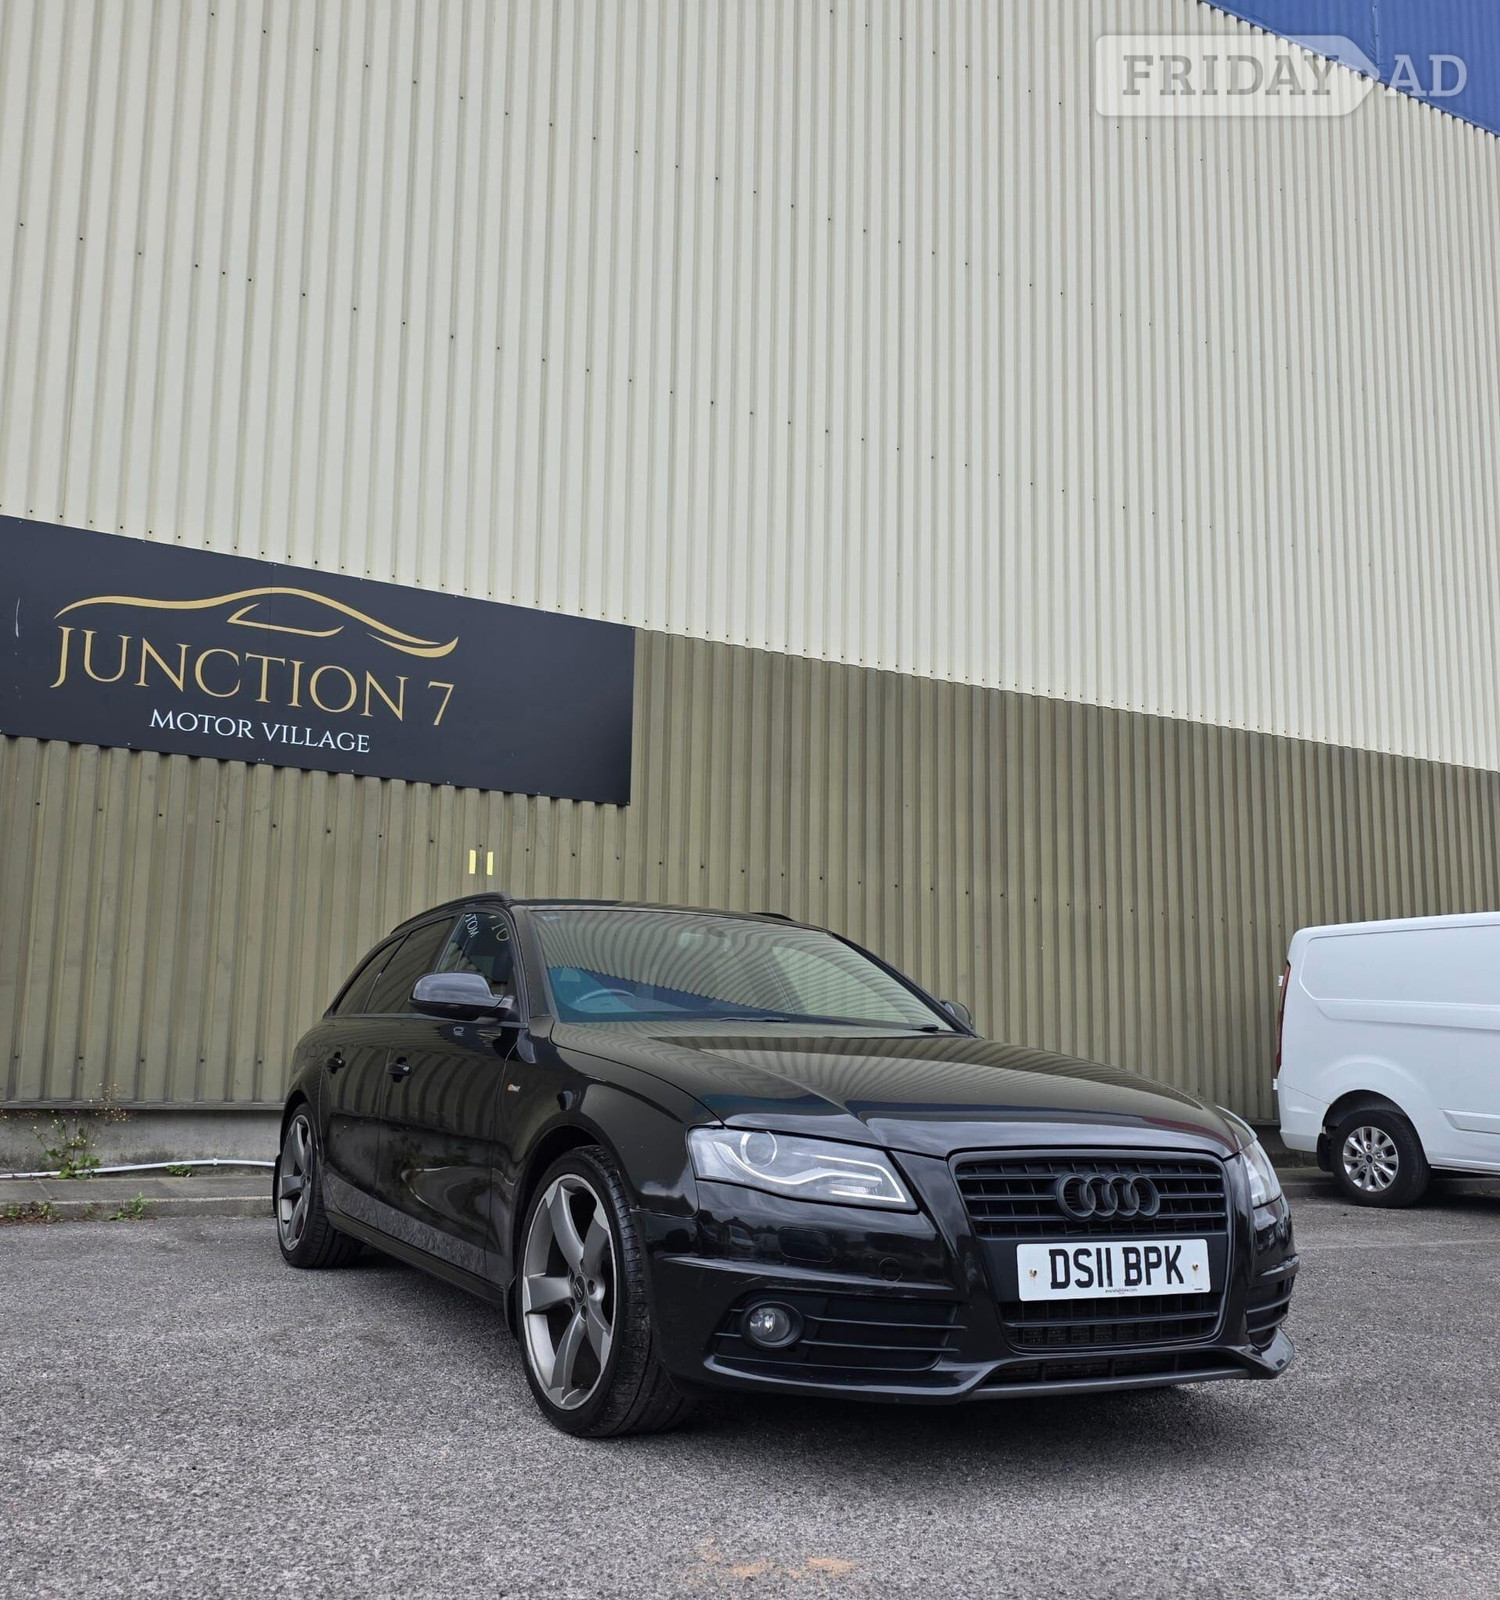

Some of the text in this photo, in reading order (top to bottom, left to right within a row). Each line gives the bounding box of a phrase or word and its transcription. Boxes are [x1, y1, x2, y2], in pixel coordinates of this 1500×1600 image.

[50, 625, 455, 726] JUNCTION 7
[149, 708, 371, 753] MOTOR VILLAGE
[1048, 1244, 1185, 1290] DS11 BPK
